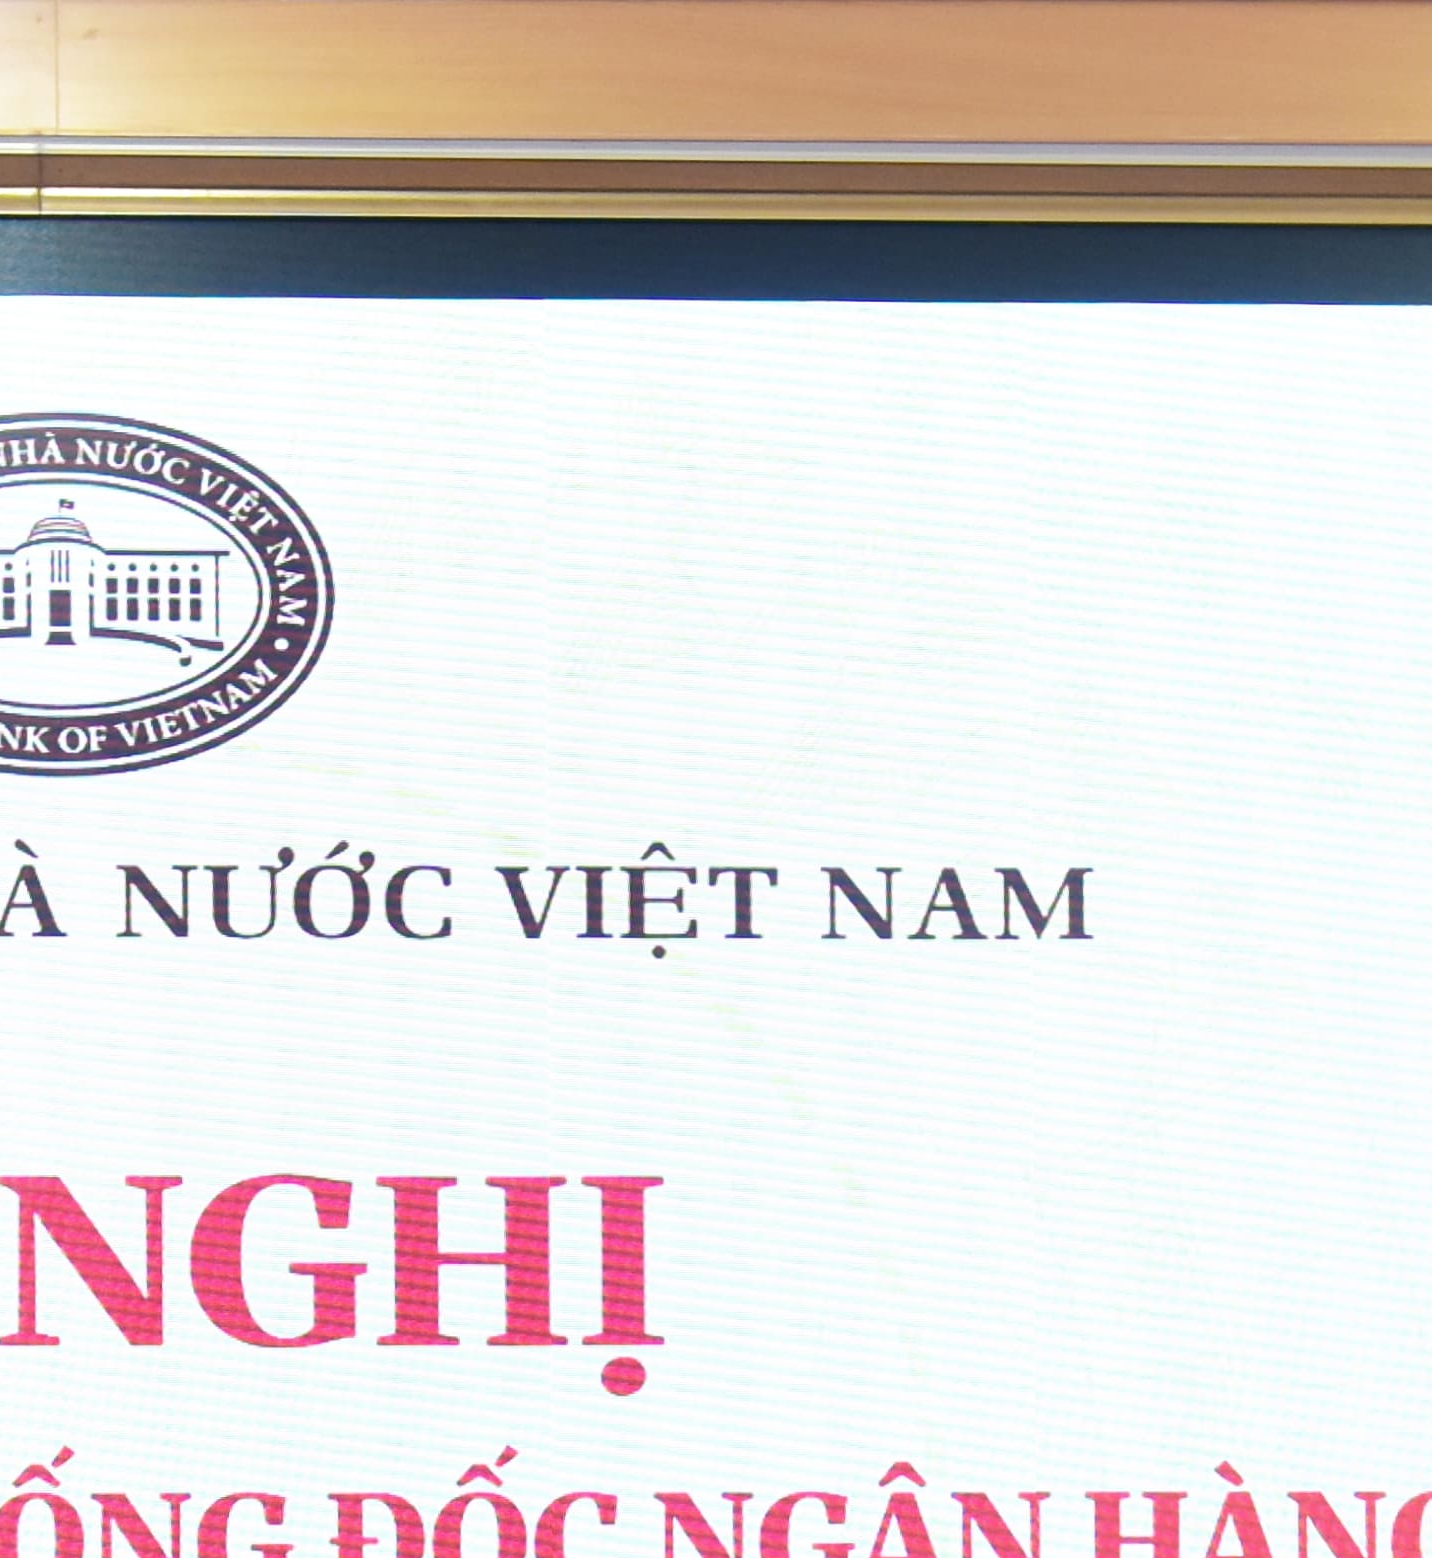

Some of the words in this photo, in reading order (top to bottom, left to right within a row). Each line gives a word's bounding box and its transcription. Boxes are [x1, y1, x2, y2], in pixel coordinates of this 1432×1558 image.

[76, 438, 191, 484] NƯỚC
[200, 469, 278, 536] VIỆT
[266, 537, 307, 627] NAM
[57, 726, 107, 754] OF
[113, 658, 279, 748] VIETNAM
[117, 841, 452, 941] NƯỚC
[495, 842, 778, 959] VIỆT
[821, 866, 1093, 941] NAM
[0, 1173, 665, 1397] NGHỊ
